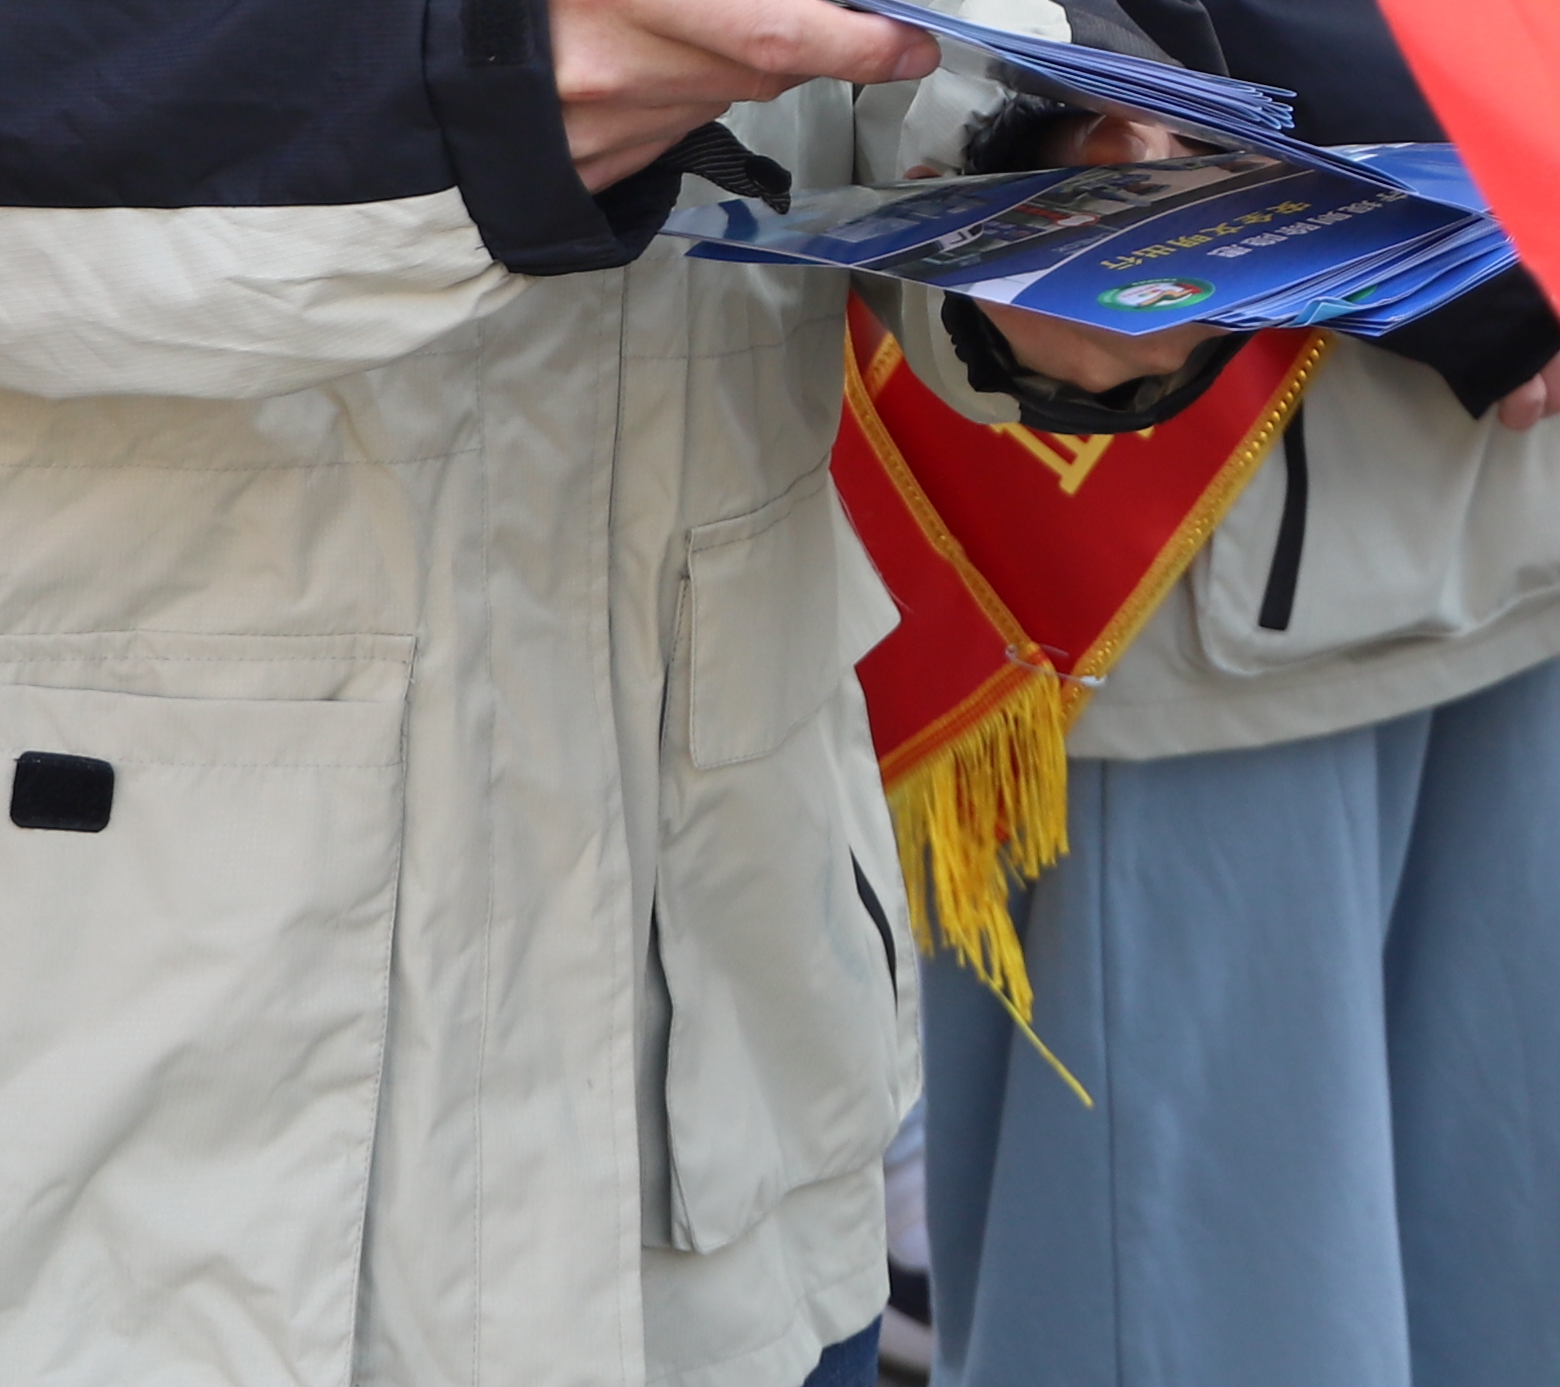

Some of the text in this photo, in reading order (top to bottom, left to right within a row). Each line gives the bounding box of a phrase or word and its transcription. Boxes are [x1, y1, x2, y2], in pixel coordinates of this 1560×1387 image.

[1100, 199, 1312, 271] 安全文明出行
